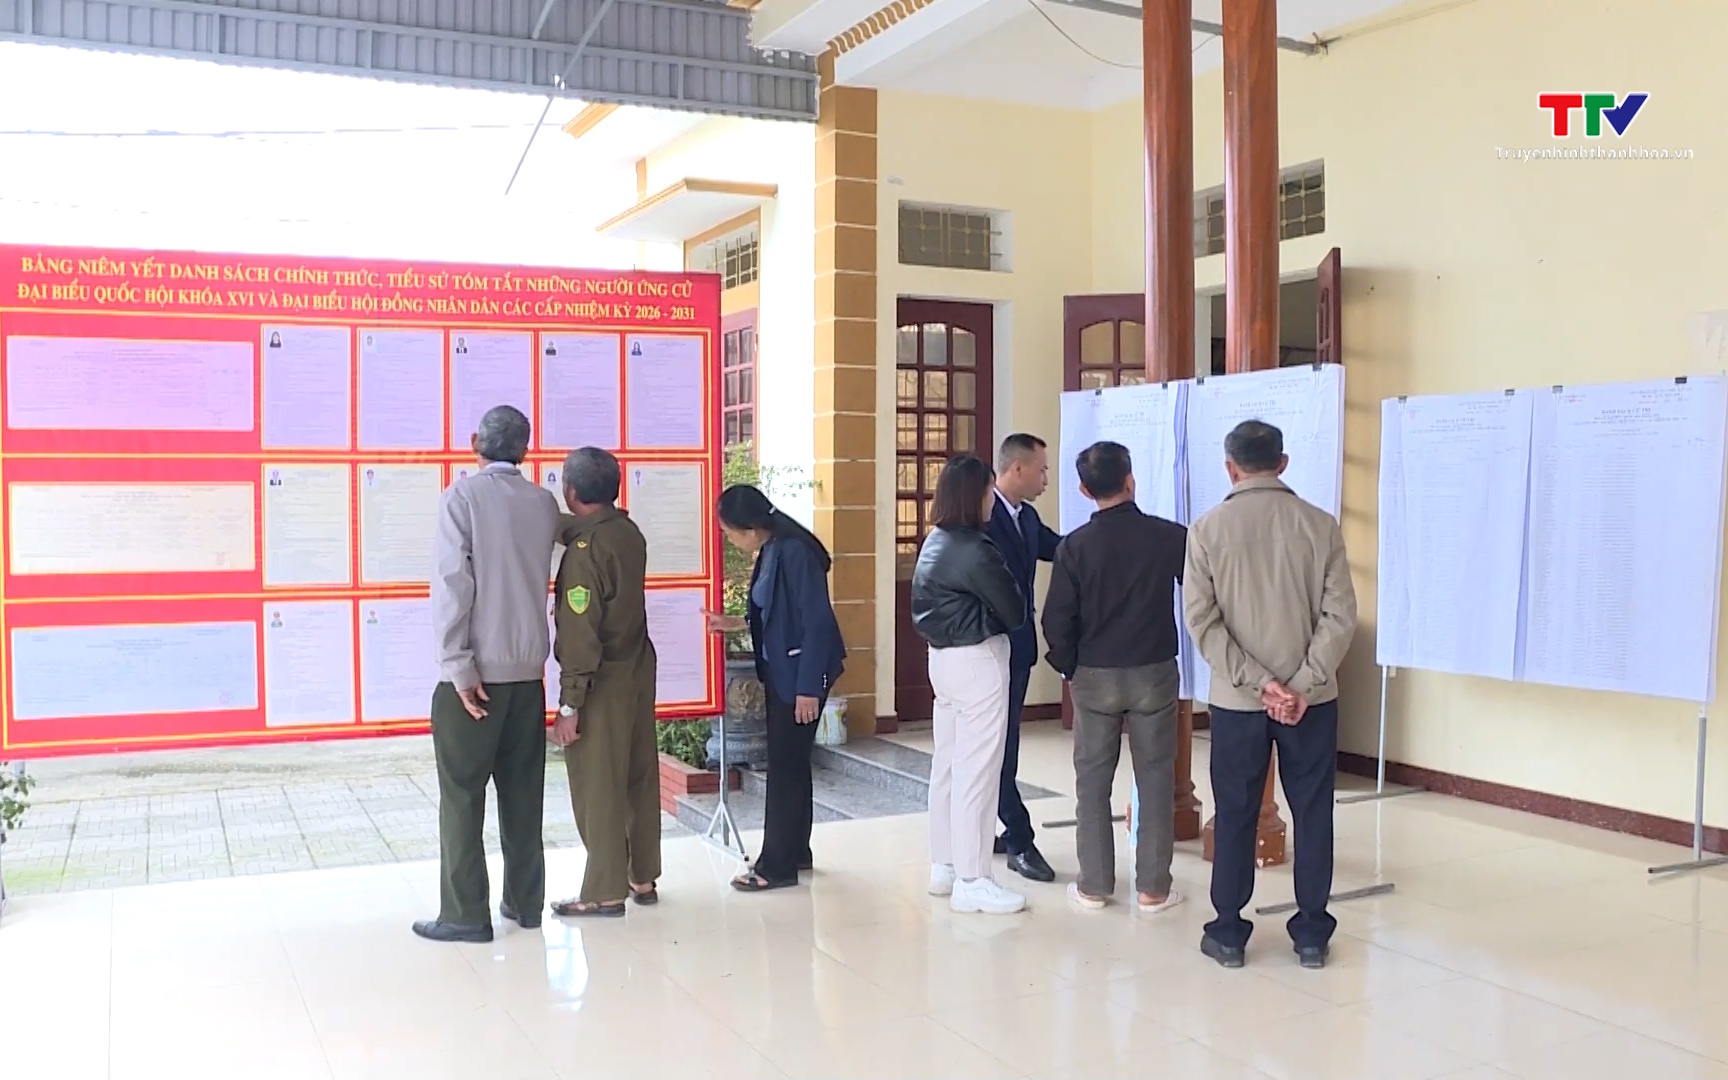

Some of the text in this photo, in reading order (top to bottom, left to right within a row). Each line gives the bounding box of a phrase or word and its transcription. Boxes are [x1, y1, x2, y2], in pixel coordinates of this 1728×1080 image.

[21, 252, 73, 275] BẢNG
[78, 256, 126, 276] NIÊM
[130, 256, 166, 278] YẾT
[170, 263, 219, 280] DANH
[223, 262, 270, 282] SÁCH
[273, 265, 328, 286] CHÍNH
[386, 265, 424, 288] TIỂU
[428, 271, 449, 290] SỬ
[452, 272, 489, 291] TÓM
[492, 271, 523, 292] TẮT
[526, 275, 581, 295] NHỮNG
[585, 278, 633, 296] NGƯỜI
[637, 278, 668, 297] ỨNG
[17, 283, 48, 304] ĐẠI
[52, 277, 90, 301] BIỂU
[94, 280, 141, 305] QUỐC
[145, 284, 174, 308] HỘI
[178, 286, 223, 306] KHÓA
[227, 291, 254, 307] XVI
[258, 289, 279, 308] VÀ
[282, 293, 309, 312] ĐẠI
[313, 289, 348, 311] BIỂU
[351, 293, 378, 315] HỘI
[381, 291, 423, 313] ĐỒNG
[427, 295, 467, 314] NHÂN
[470, 296, 499, 315] DÂN
[502, 297, 532, 316] CÁC
[535, 295, 562, 316] CẤP
[565, 299, 609, 320] NHIỆM
[635, 304, 661, 320] 2026
[670, 306, 695, 320] 2031
